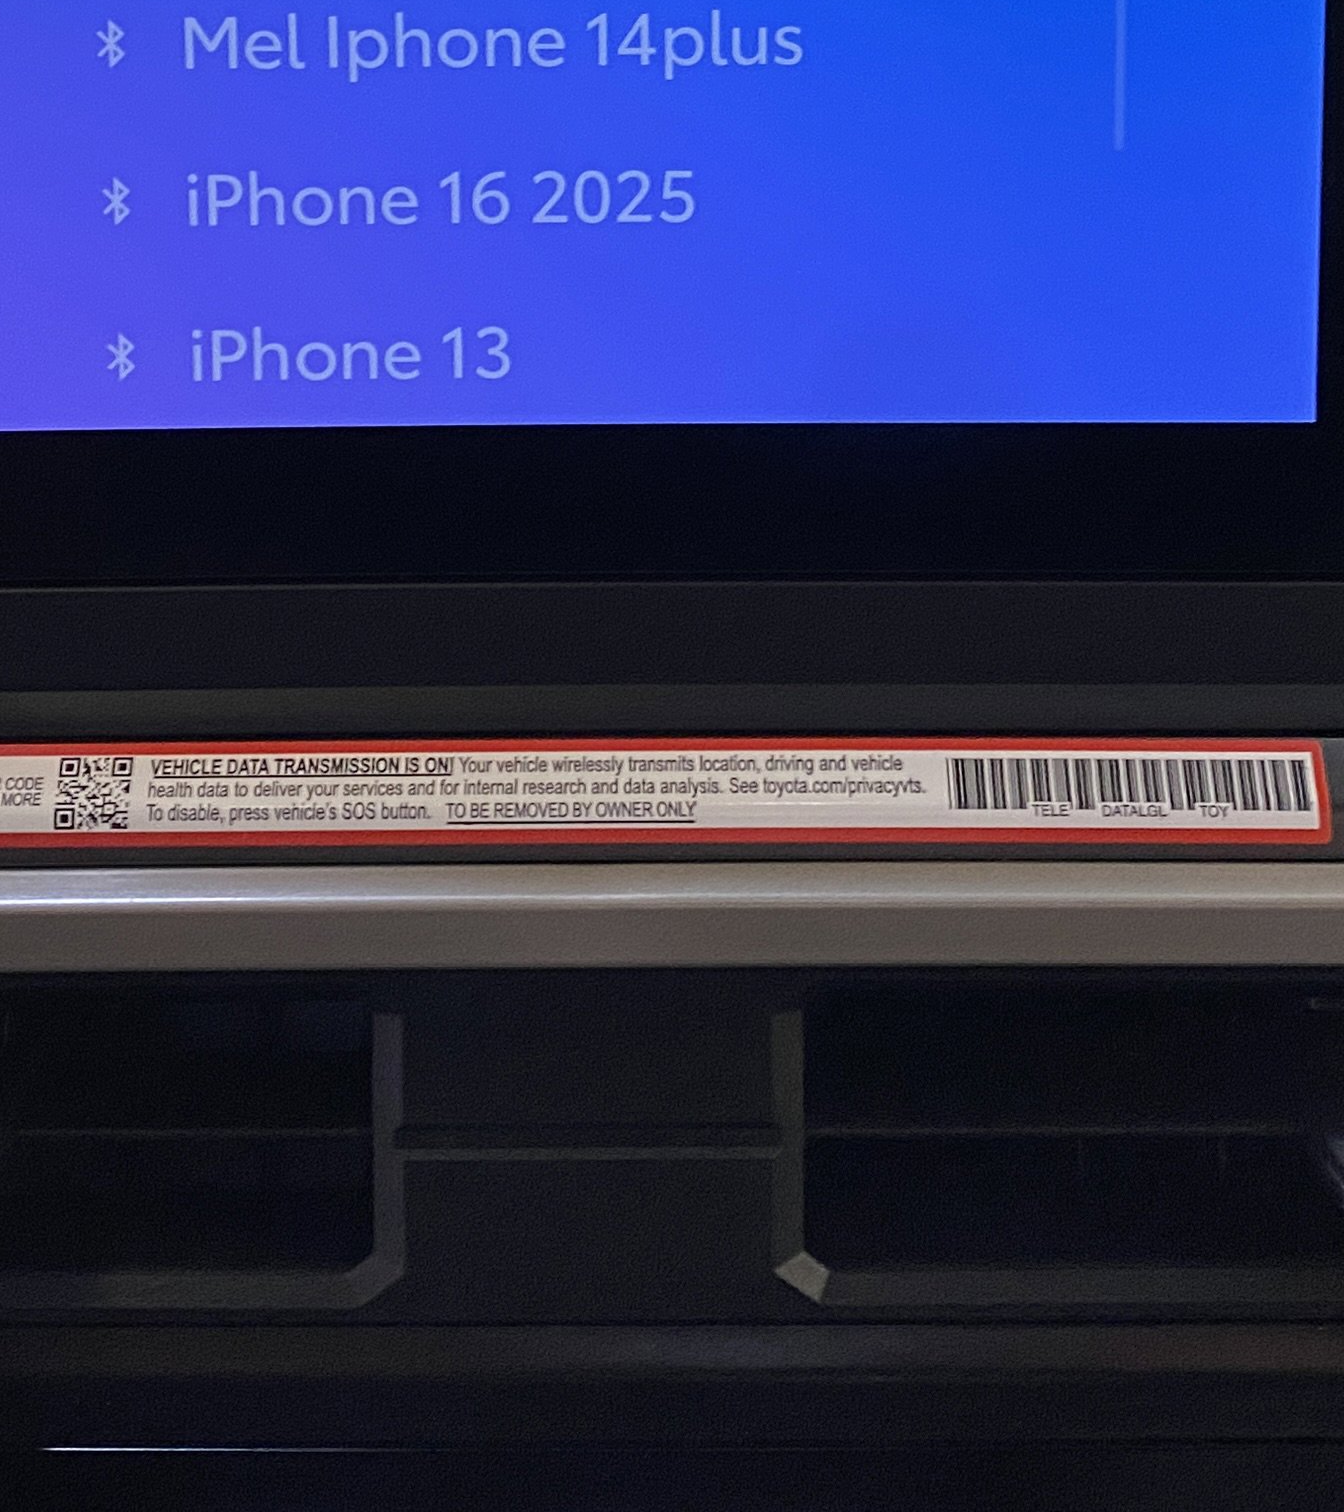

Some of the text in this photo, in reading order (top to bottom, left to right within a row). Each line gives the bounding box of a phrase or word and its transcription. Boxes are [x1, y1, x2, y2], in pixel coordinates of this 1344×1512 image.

[182, 9, 805, 83] Mel Iphone 14plus
[186, 169, 696, 227] iPhone 16 2025
[191, 325, 512, 382] iPhone 13
[151, 759, 222, 775] VEHICLE
[226, 759, 270, 774] DATA
[274, 758, 401, 774] TRANSMISSION
[405, 757, 420, 773] IS
[459, 757, 493, 773] Your
[496, 756, 548, 772] vehicle
[550, 756, 624, 775] wirelessly
[628, 755, 695, 772] transmits
[699, 755, 761, 774] location,
[765, 754, 814, 775] driving
[819, 754, 847, 771] and
[851, 754, 904, 771] vehicle
[5, 777, 44, 790] CODE
[147, 777, 927, 800] health data to deliver your services and for internal research and data analysis. See toyota.com/privacyvts.
[0, 793, 41, 806] MORE
[1031, 804, 1230, 818] TELE DATALGL TOY
[146, 801, 697, 825] To disable, press vehicle's SOS button. TO BE REMOVED BY OWNER ONLY
